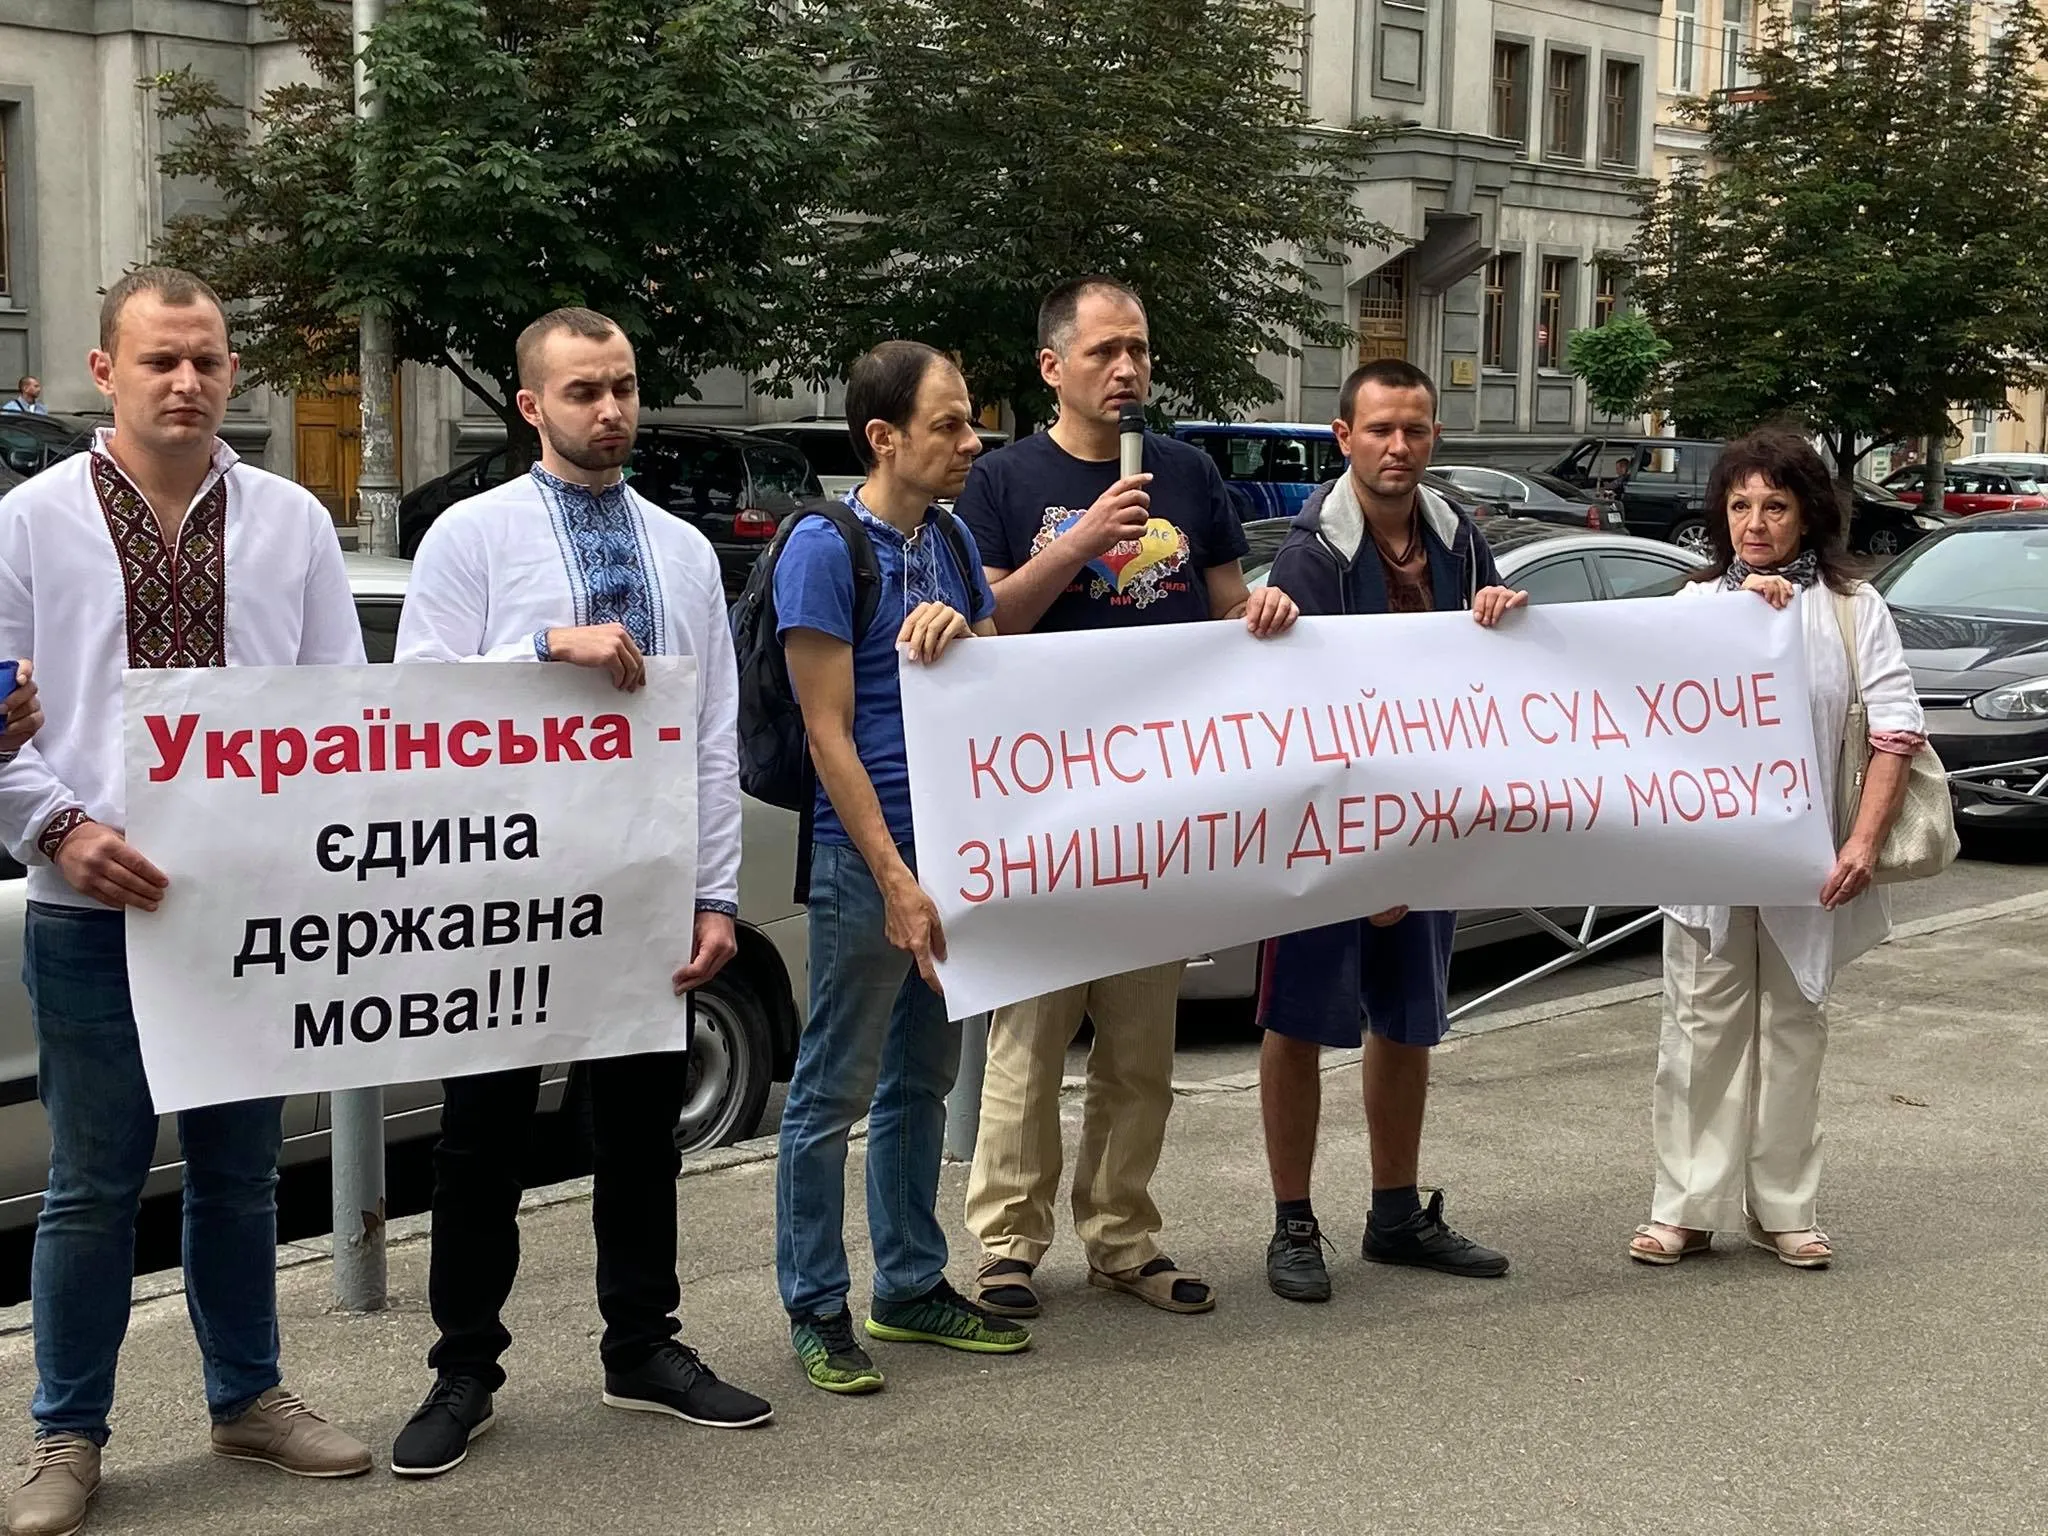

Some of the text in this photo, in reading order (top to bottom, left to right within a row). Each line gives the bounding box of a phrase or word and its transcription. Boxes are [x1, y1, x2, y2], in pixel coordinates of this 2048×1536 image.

[143, 708, 633, 796] Українська
[968, 672, 1782, 799] КОНСТИТУЦІЙНИЙ СУД ХОЧЕ
[316, 813, 540, 882] єдина
[957, 758, 1813, 905] ЗНИЩИТИ ДЕРЖАВНУ МОВУ?!
[233, 893, 604, 978] державна
[294, 964, 550, 1049] мова!!!
